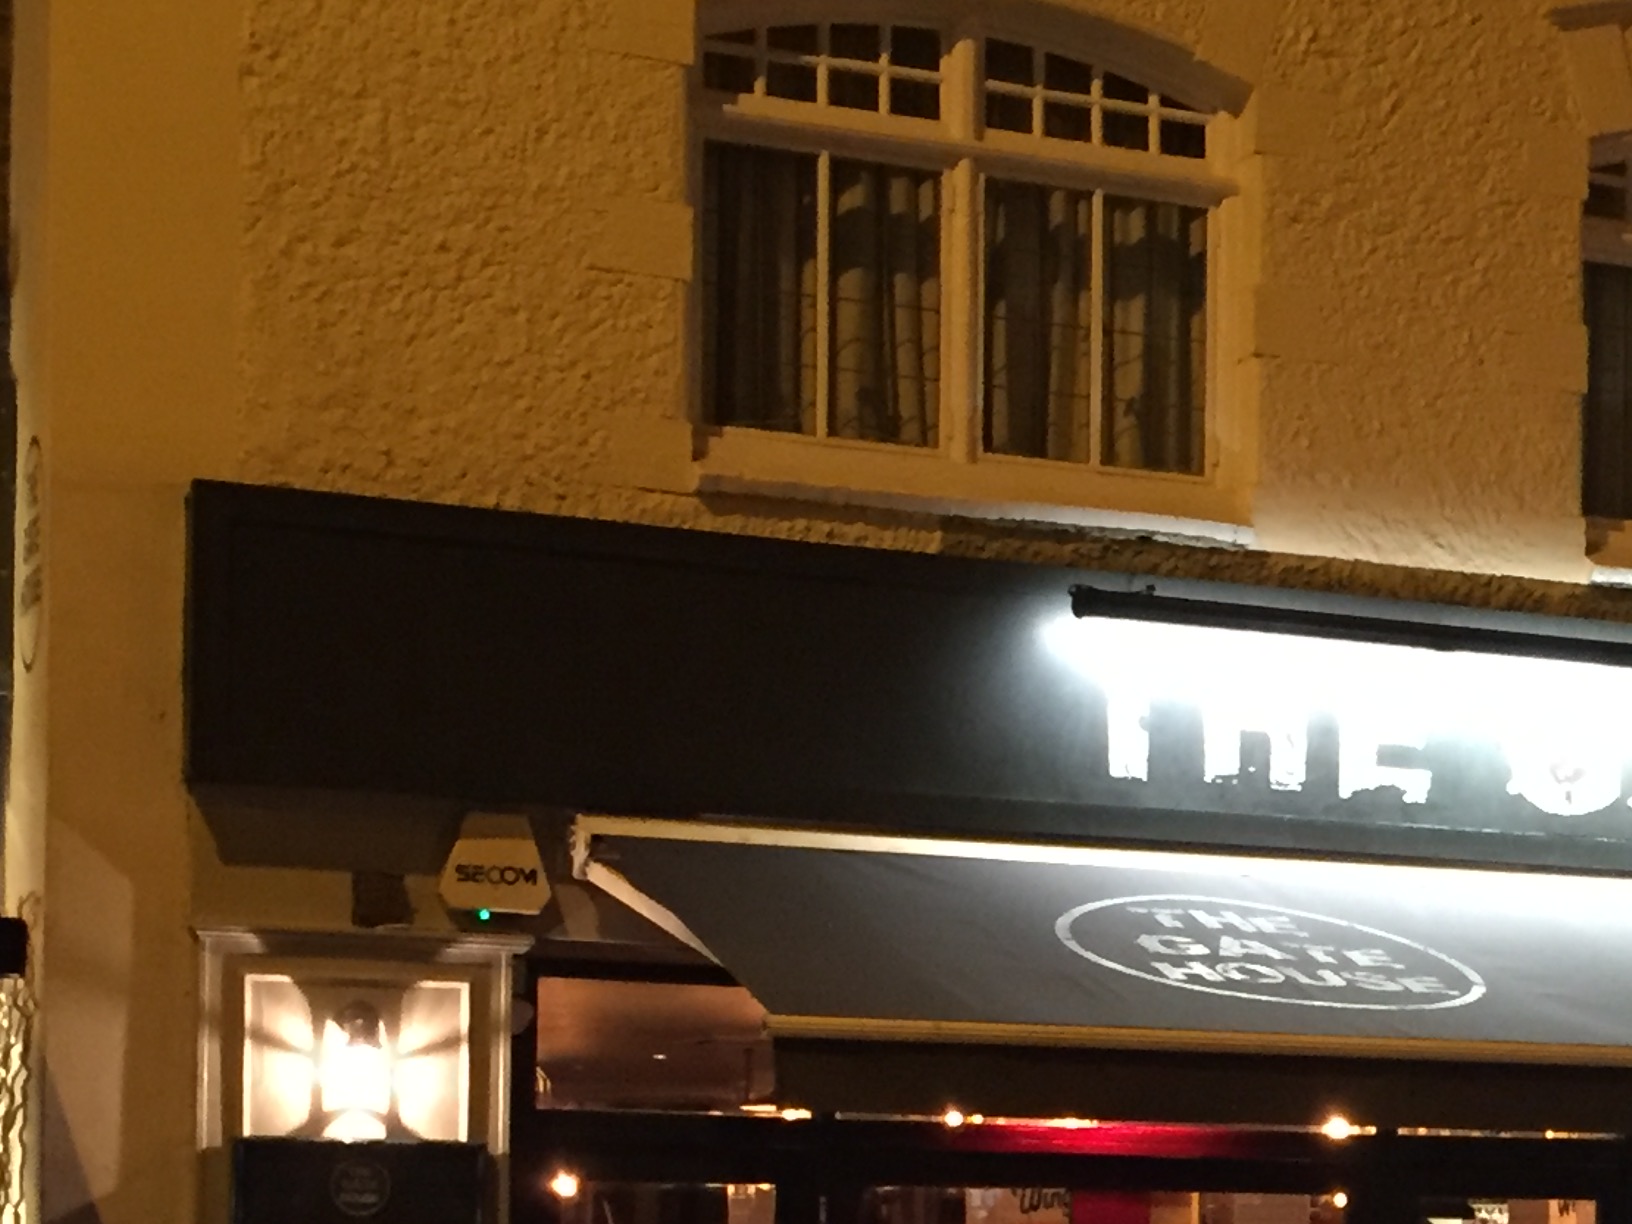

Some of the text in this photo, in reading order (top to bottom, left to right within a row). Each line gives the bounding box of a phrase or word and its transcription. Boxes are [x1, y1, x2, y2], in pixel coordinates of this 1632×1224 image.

[455, 864, 538, 886] SECOM
[1126, 905, 1310, 937] THE
[1135, 933, 1405, 970] GATE
[1150, 961, 1461, 997] HOUSE
